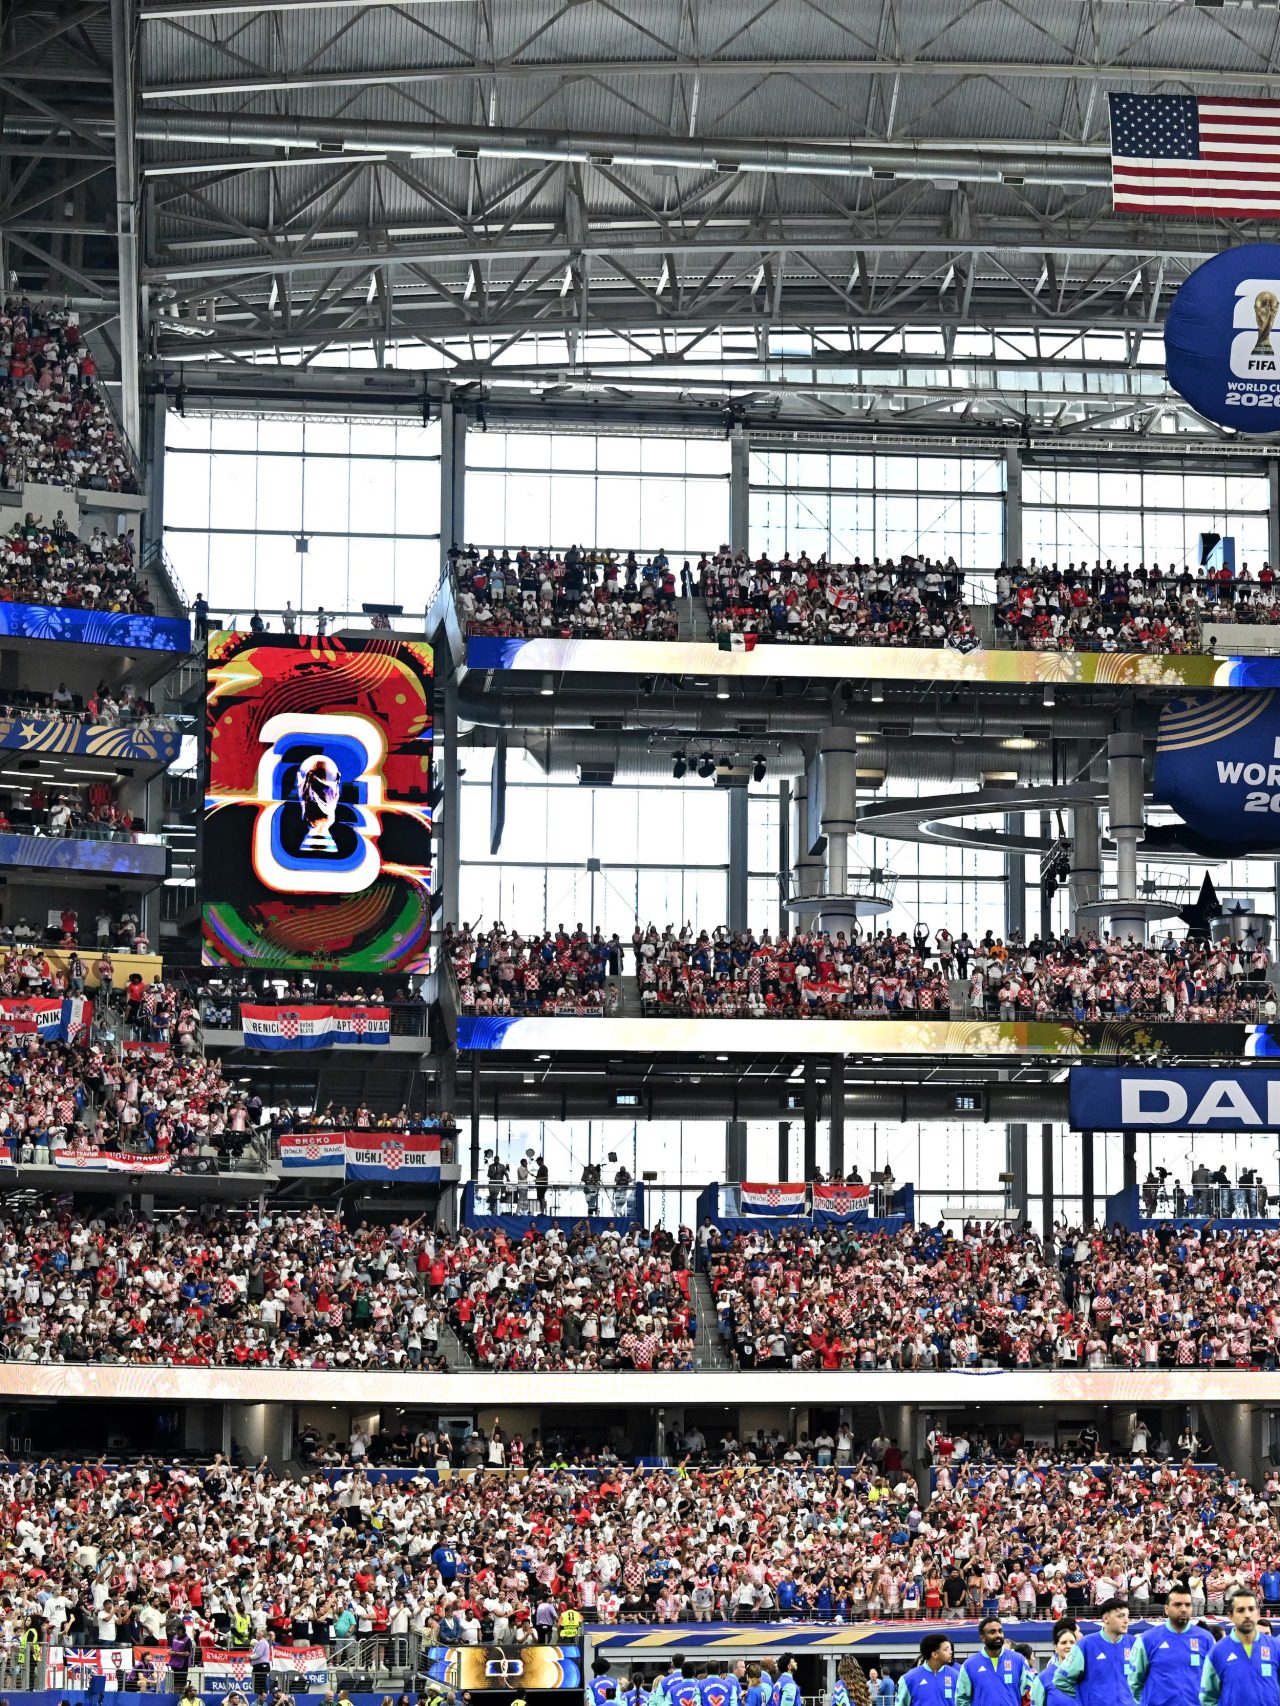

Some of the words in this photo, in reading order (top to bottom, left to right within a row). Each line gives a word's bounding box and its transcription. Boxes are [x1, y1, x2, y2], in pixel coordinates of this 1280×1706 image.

[1247, 360, 1277, 371] FIFA
[1227, 381, 1268, 392] WORLD
[295, 1136, 330, 1145] BRČKO
[703, 1683, 729, 1694] VOLUNTEER
